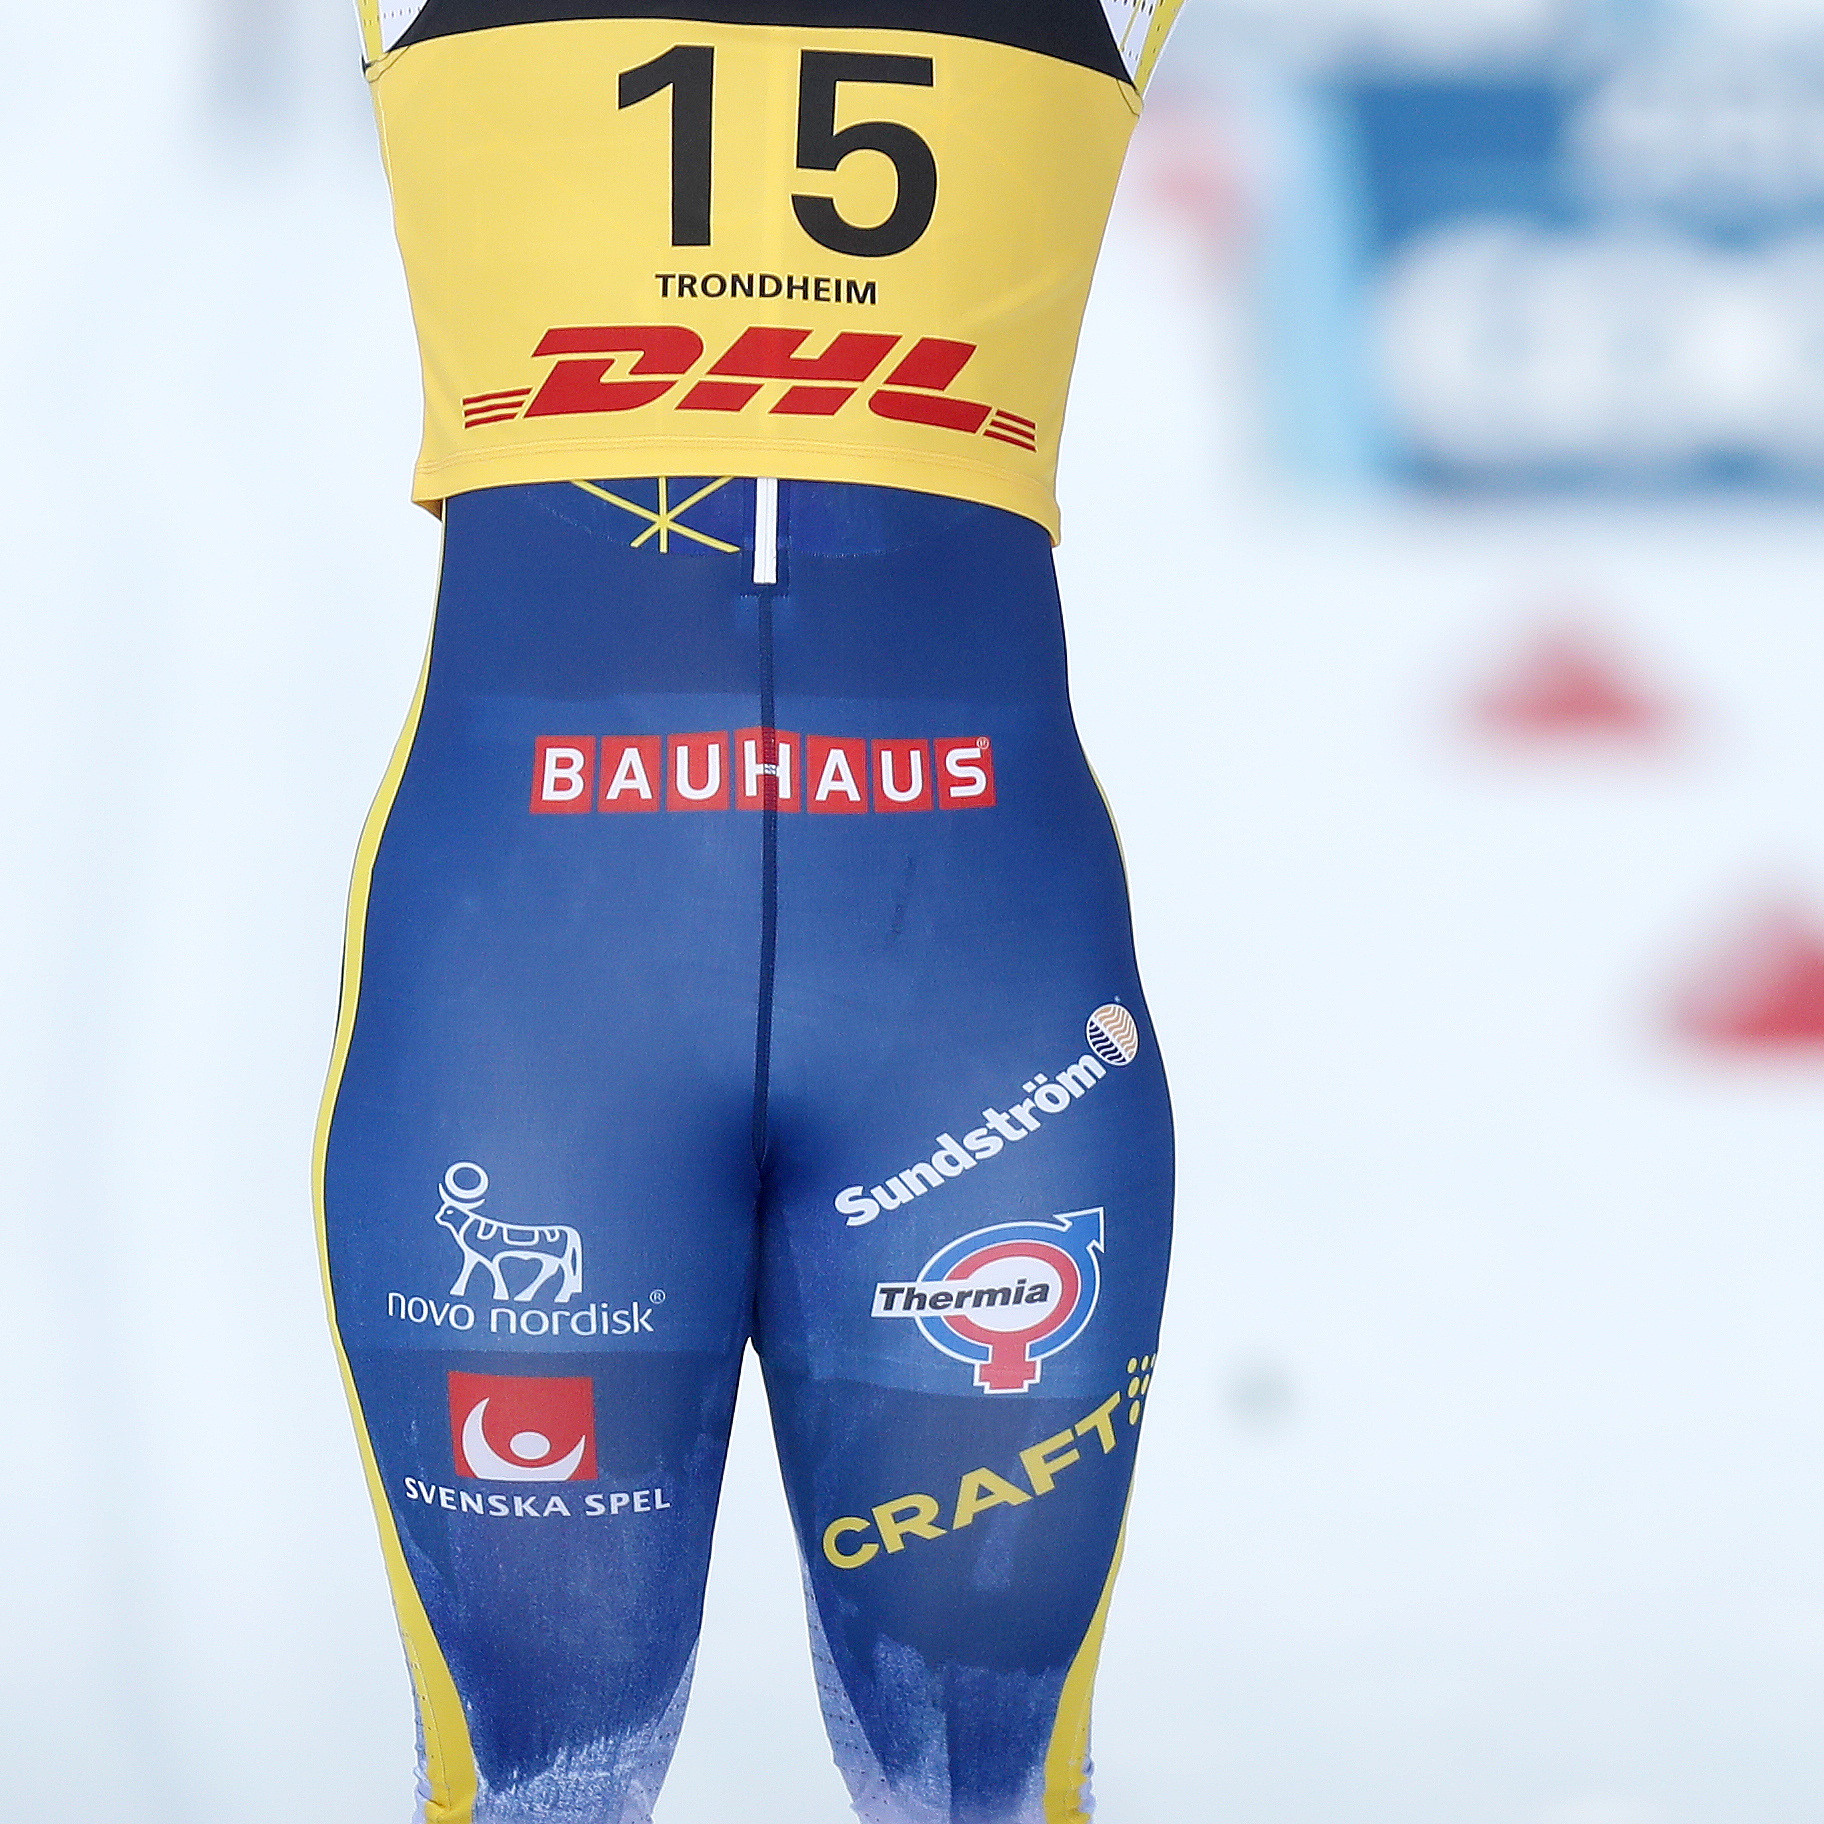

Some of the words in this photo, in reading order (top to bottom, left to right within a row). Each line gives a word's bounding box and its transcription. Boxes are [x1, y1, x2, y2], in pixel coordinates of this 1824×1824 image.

[617, 45, 939, 258] 15
[654, 272, 879, 307] TRONDHEIM
[522, 325, 993, 434] DHL
[540, 739, 988, 803] BAUHAUS
[833, 1051, 1107, 1227] Sundström
[386, 1291, 476, 1332] novo
[490, 1301, 655, 1336] nordisk
[878, 1277, 1051, 1312] Thermia
[404, 1476, 572, 1518] SVENSKA
[584, 1487, 672, 1517] SPEL
[822, 1390, 1123, 1570] CRAFT
